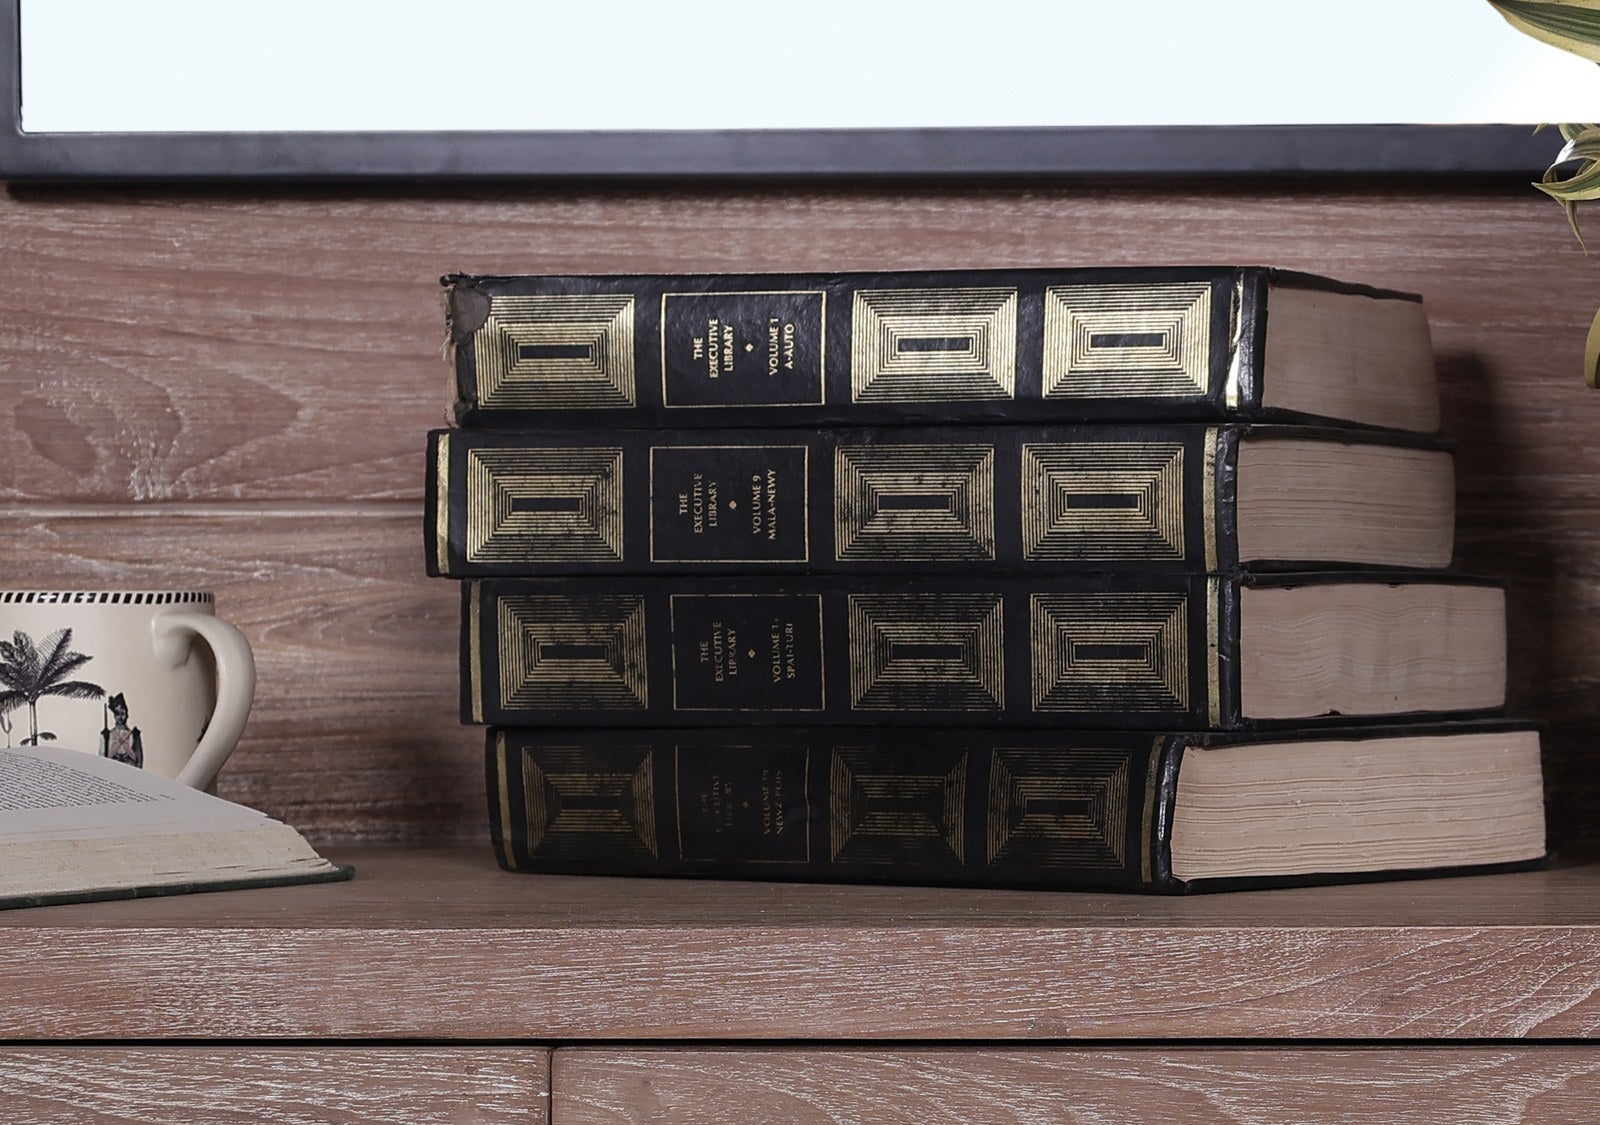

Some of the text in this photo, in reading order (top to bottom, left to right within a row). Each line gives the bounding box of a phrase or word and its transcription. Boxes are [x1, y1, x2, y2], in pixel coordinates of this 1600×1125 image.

[693, 337, 703, 360] THE
[709, 318, 719, 378] EXECUTIVE
[724, 325, 733, 371] LIBRARY
[769, 325, 779, 376] VOLUME
[784, 323, 795, 370] A-AUTO
[679, 493, 688, 515] THE
[694, 473, 703, 533] EXECUTIVE
[708, 480, 717, 527] LIBRARY
[752, 484, 761, 534] VOLUME
[767, 469, 776, 540] MALA-NEWY
[700, 641, 709, 663] THE
[713, 621, 724, 682] EXECUTIVE
[727, 628, 737, 675] LIBRARY
[771, 633, 781, 684] VOLUME
[762, 784, 772, 835] VOLUME
